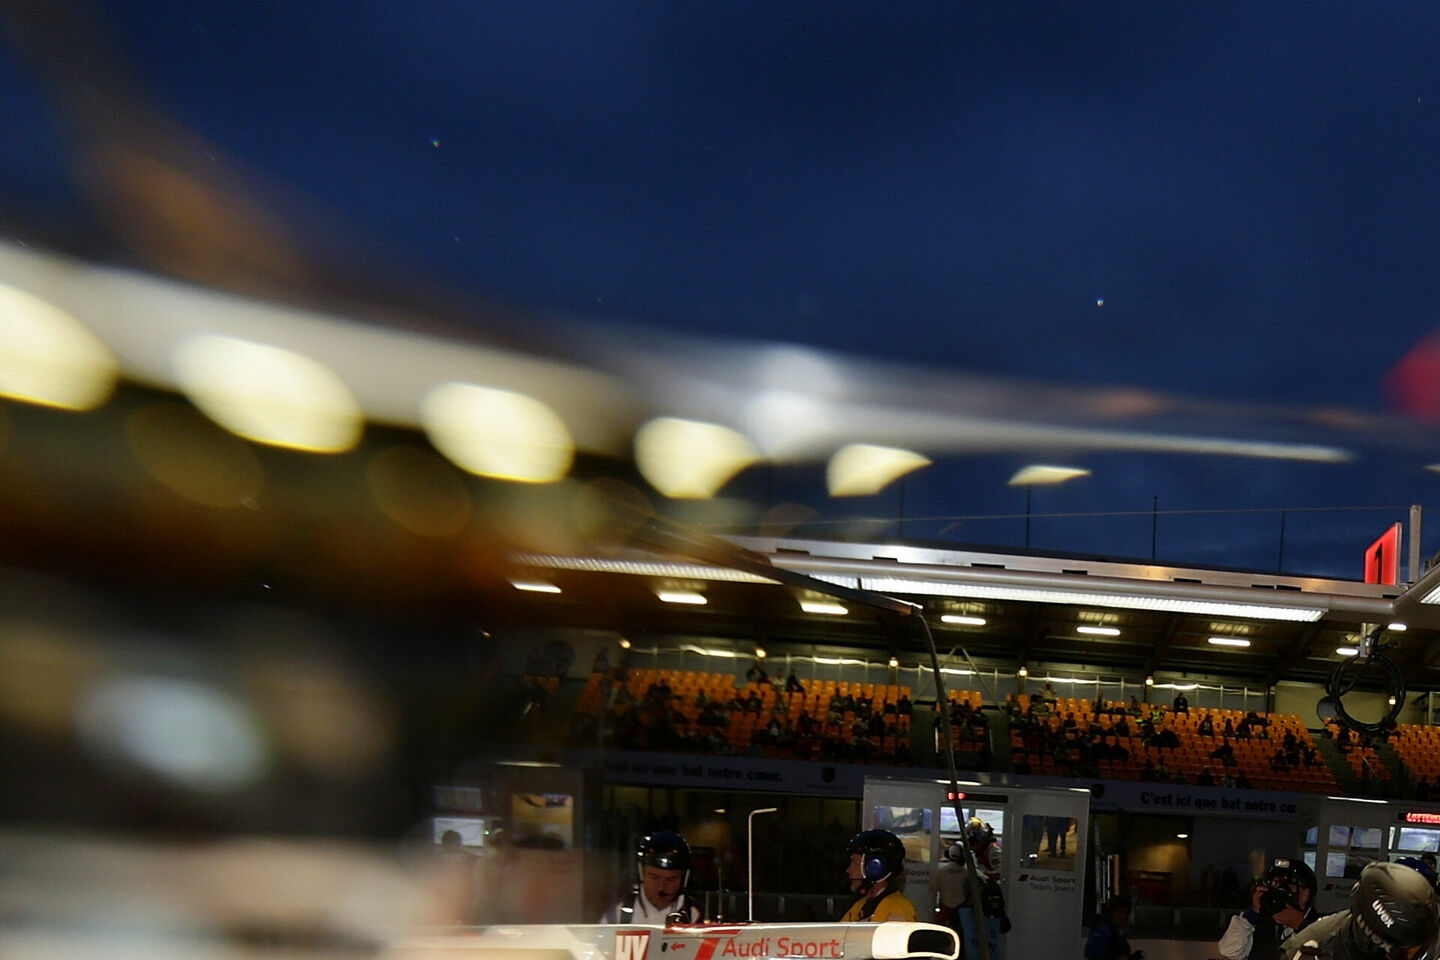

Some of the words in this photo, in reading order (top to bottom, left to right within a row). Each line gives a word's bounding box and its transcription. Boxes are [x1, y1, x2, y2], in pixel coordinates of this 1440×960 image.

[1176, 794, 1191, 806] ici
[1195, 797, 1217, 809] que
[1221, 797, 1241, 810] bat
[1245, 799, 1276, 812] notre
[1371, 899, 1395, 929] uvex
[722, 937, 769, 957] Audi
[777, 938, 839, 958] Sport
